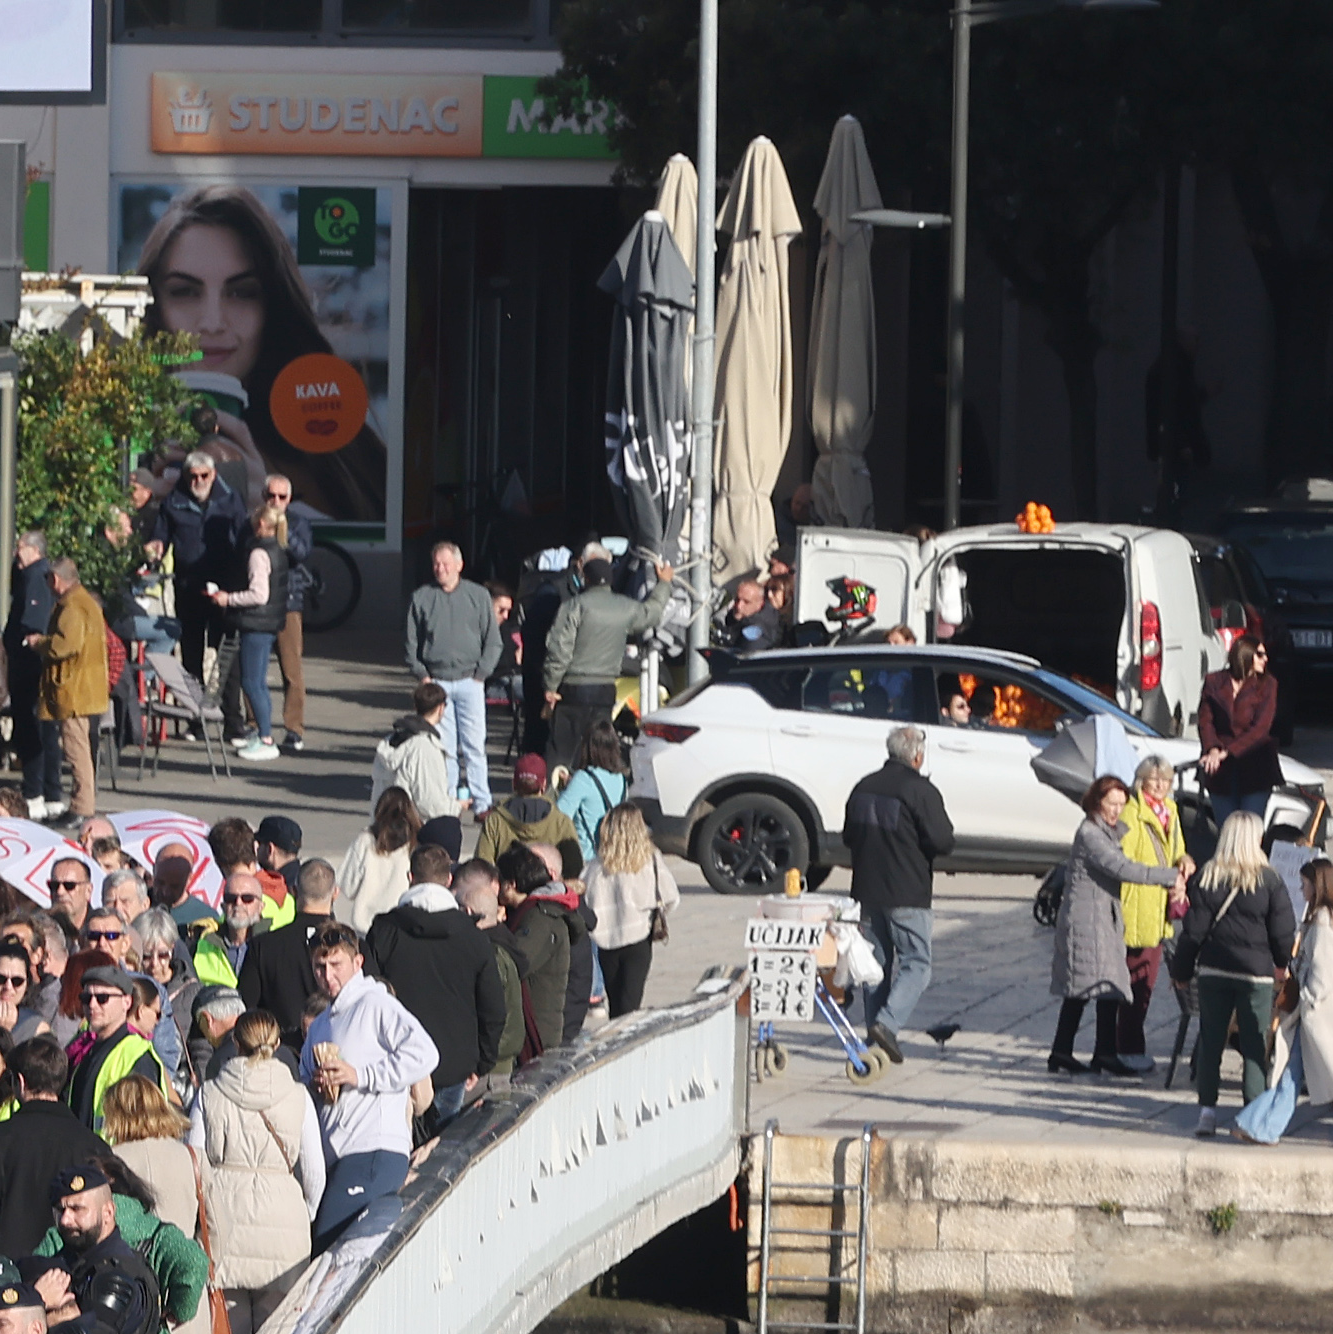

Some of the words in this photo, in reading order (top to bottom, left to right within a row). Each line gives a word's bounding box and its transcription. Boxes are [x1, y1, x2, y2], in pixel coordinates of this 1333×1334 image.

[230, 95, 460, 135] STUDENAC
[505, 97, 635, 135] MAR
[295, 382, 341, 399] KAVA
[751, 955, 759, 973] 1
[779, 955, 794, 974] 2
